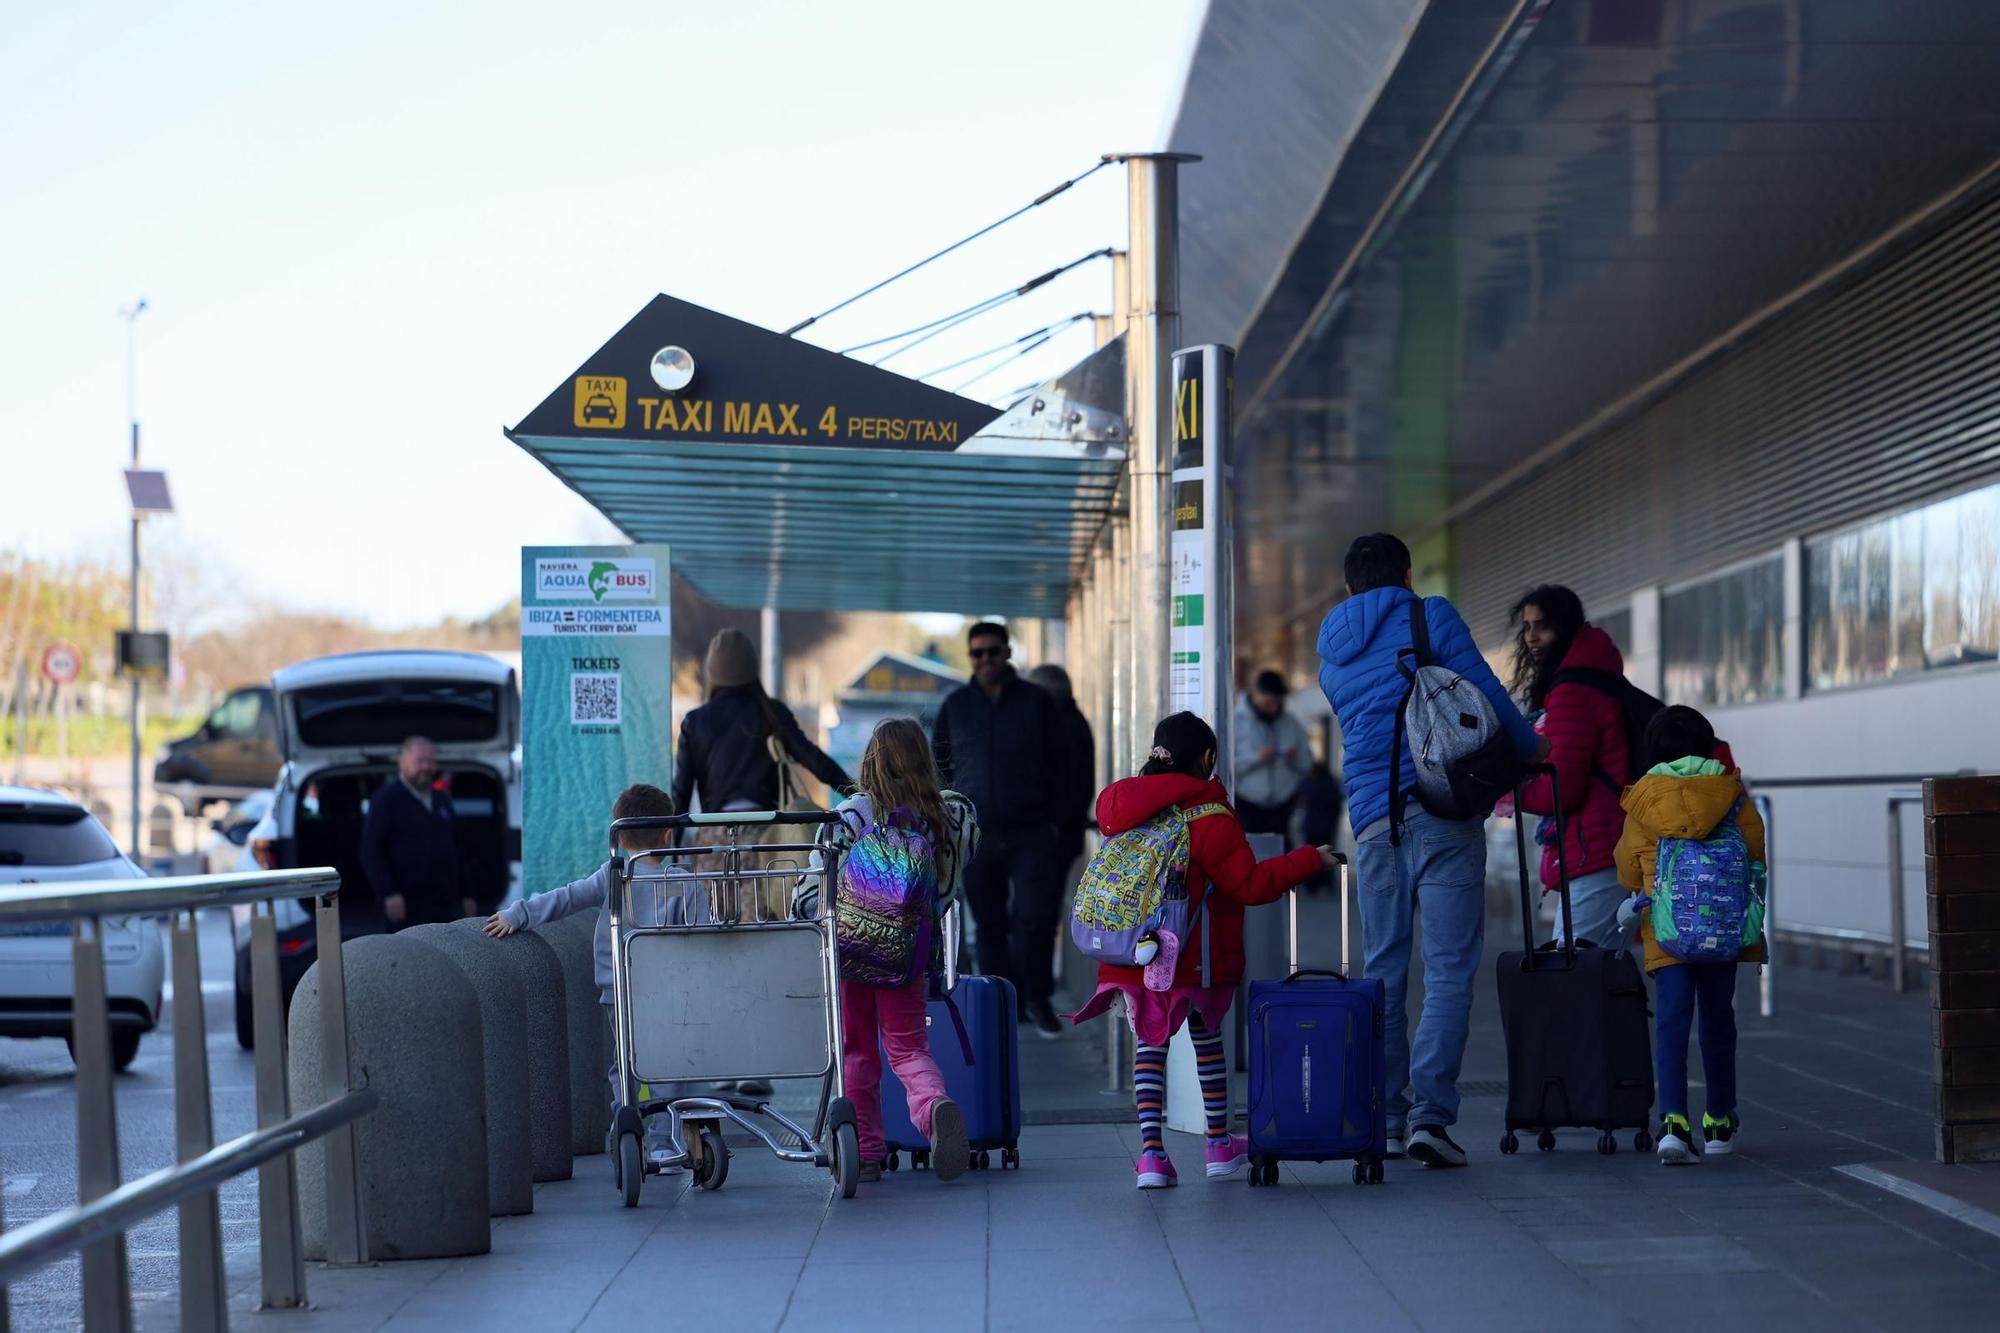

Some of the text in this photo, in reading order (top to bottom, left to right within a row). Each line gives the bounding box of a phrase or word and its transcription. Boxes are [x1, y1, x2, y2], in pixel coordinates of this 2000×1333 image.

[585, 380, 617, 392] TAXI
[638, 398, 957, 442] TAXI MAX. 4 PERS/TAXI
[540, 563, 577, 571] NAVIERA
[544, 575, 646, 586] AQUA BUS
[529, 610, 661, 623] IBIZA FORMENTERA
[554, 624, 637, 633] TURISTIC FERRY BOAT
[572, 657, 620, 670] TICKETS
